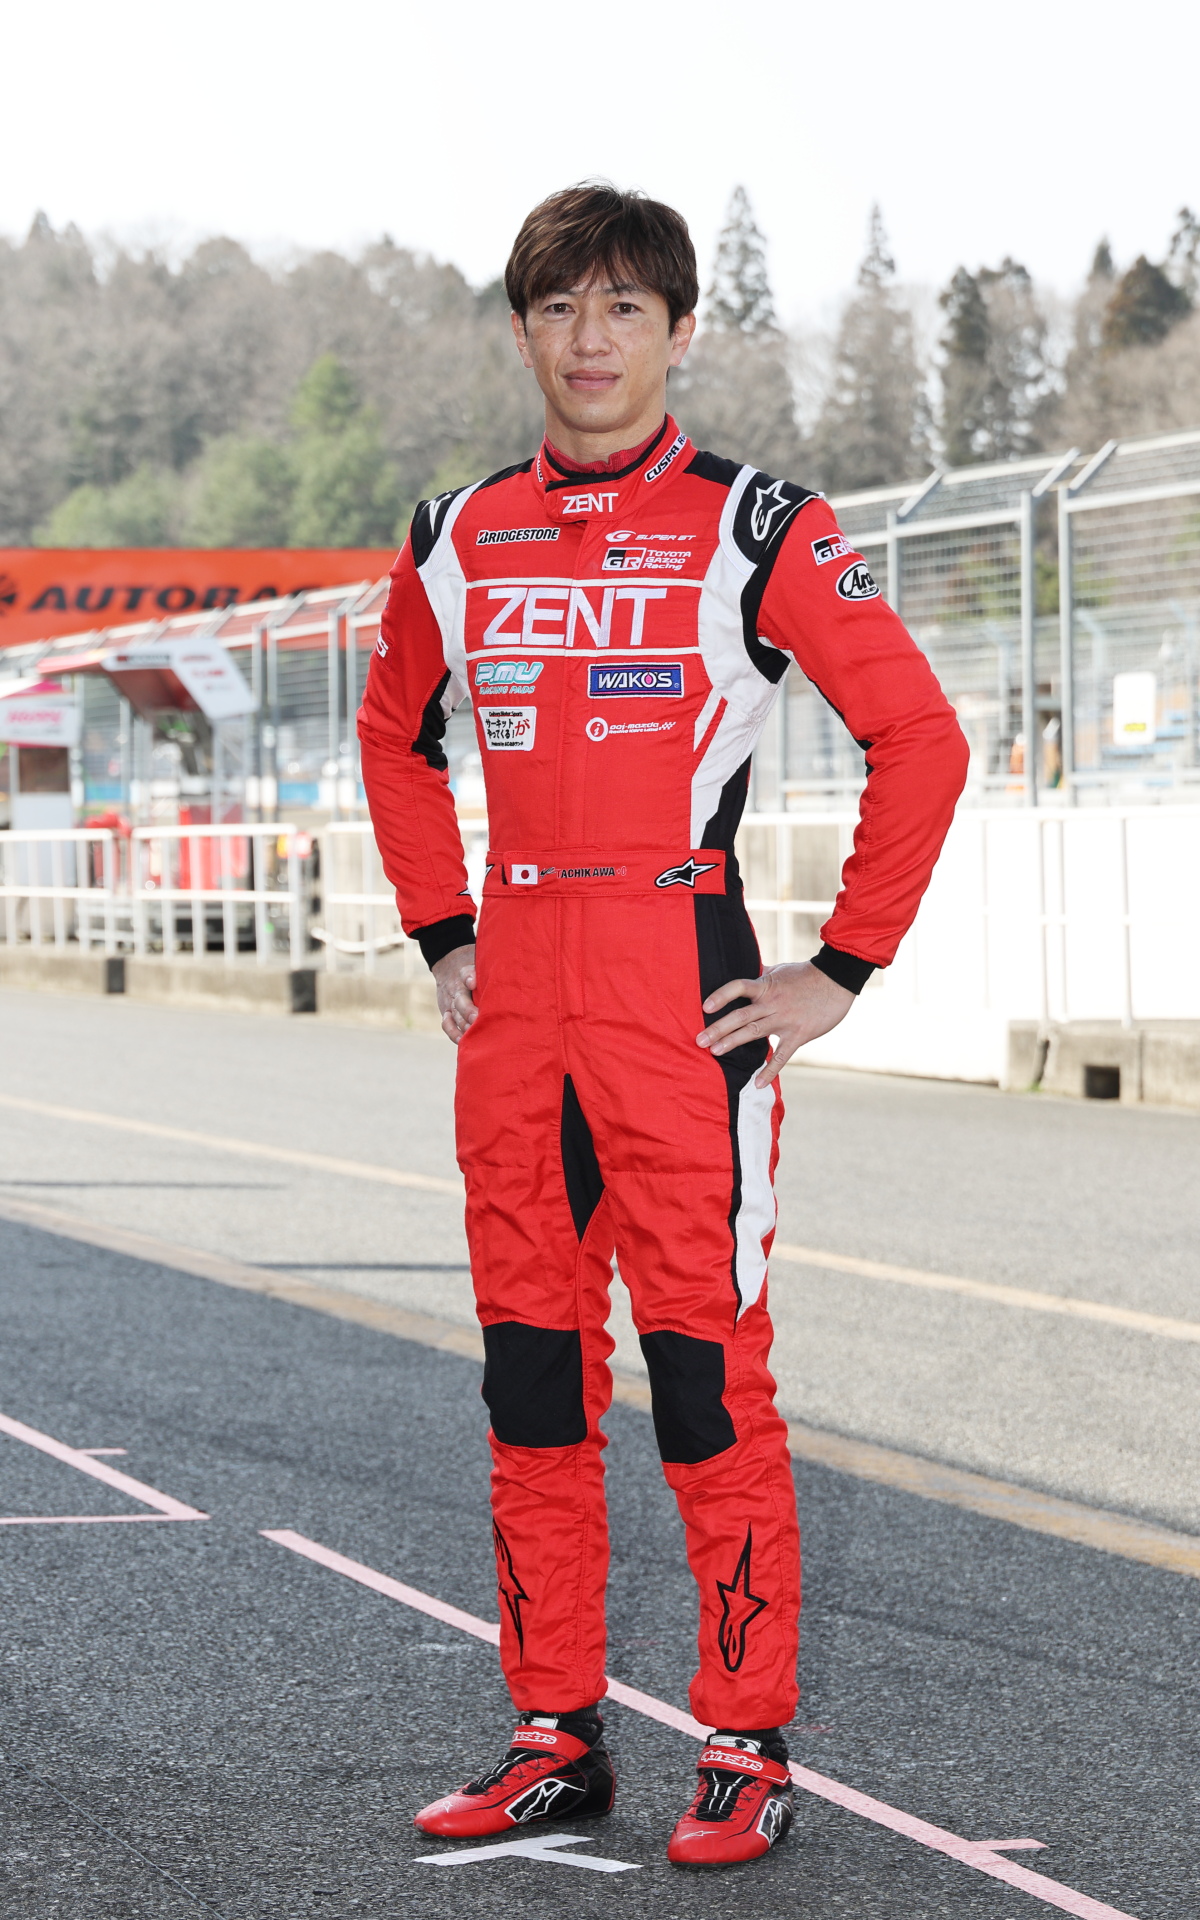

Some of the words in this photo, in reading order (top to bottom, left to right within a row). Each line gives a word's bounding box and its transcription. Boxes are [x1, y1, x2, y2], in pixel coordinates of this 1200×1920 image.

[646, 445, 680, 481] CUSPA
[563, 493, 619, 514] ZENT
[477, 529, 559, 544] BRIDGESTONE
[647, 550, 692, 558] TOYOTA
[816, 542, 846, 562] GR
[605, 556, 641, 569] GR
[642, 563, 683, 571] Racing
[483, 588, 668, 648] ZENT
[509, 685, 536, 694] PADS
[556, 867, 616, 878] TACHIKAWA
